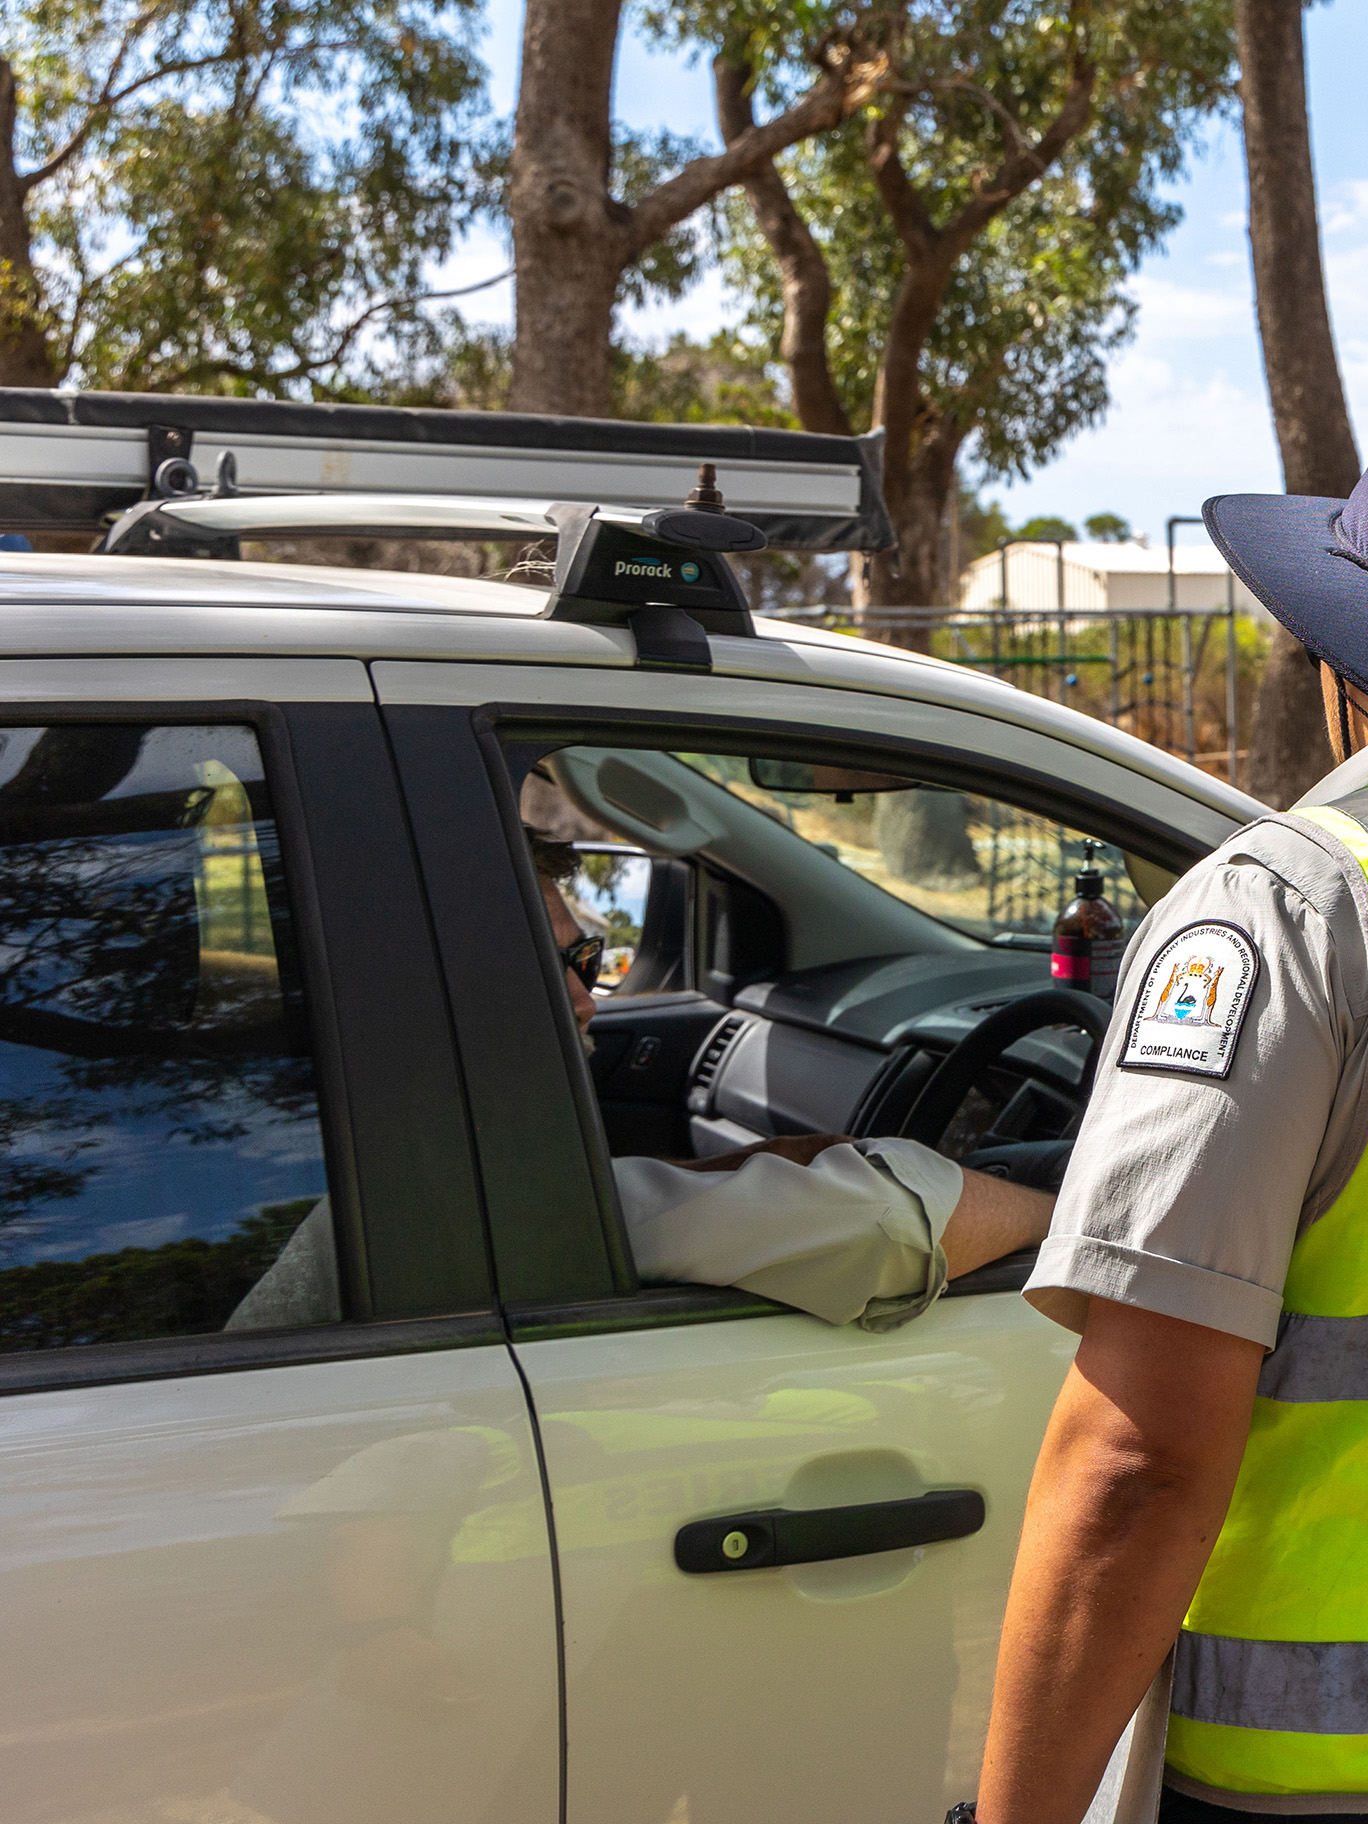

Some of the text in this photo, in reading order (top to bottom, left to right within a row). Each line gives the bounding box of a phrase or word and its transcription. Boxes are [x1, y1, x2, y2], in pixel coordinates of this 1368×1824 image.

[614, 560, 672, 578] Prorack
[1181, 927, 1228, 942] INDUSTRIES
[1226, 934, 1241, 949] AND
[1153, 940, 1179, 973] PRIMARY
[1237, 948, 1251, 990] REGIONAL
[1131, 989, 1151, 1049] DEPARTMENT
[1217, 992, 1242, 1057] DEVELOPMENT
[1140, 1045, 1209, 1062] COMPLIANCE
